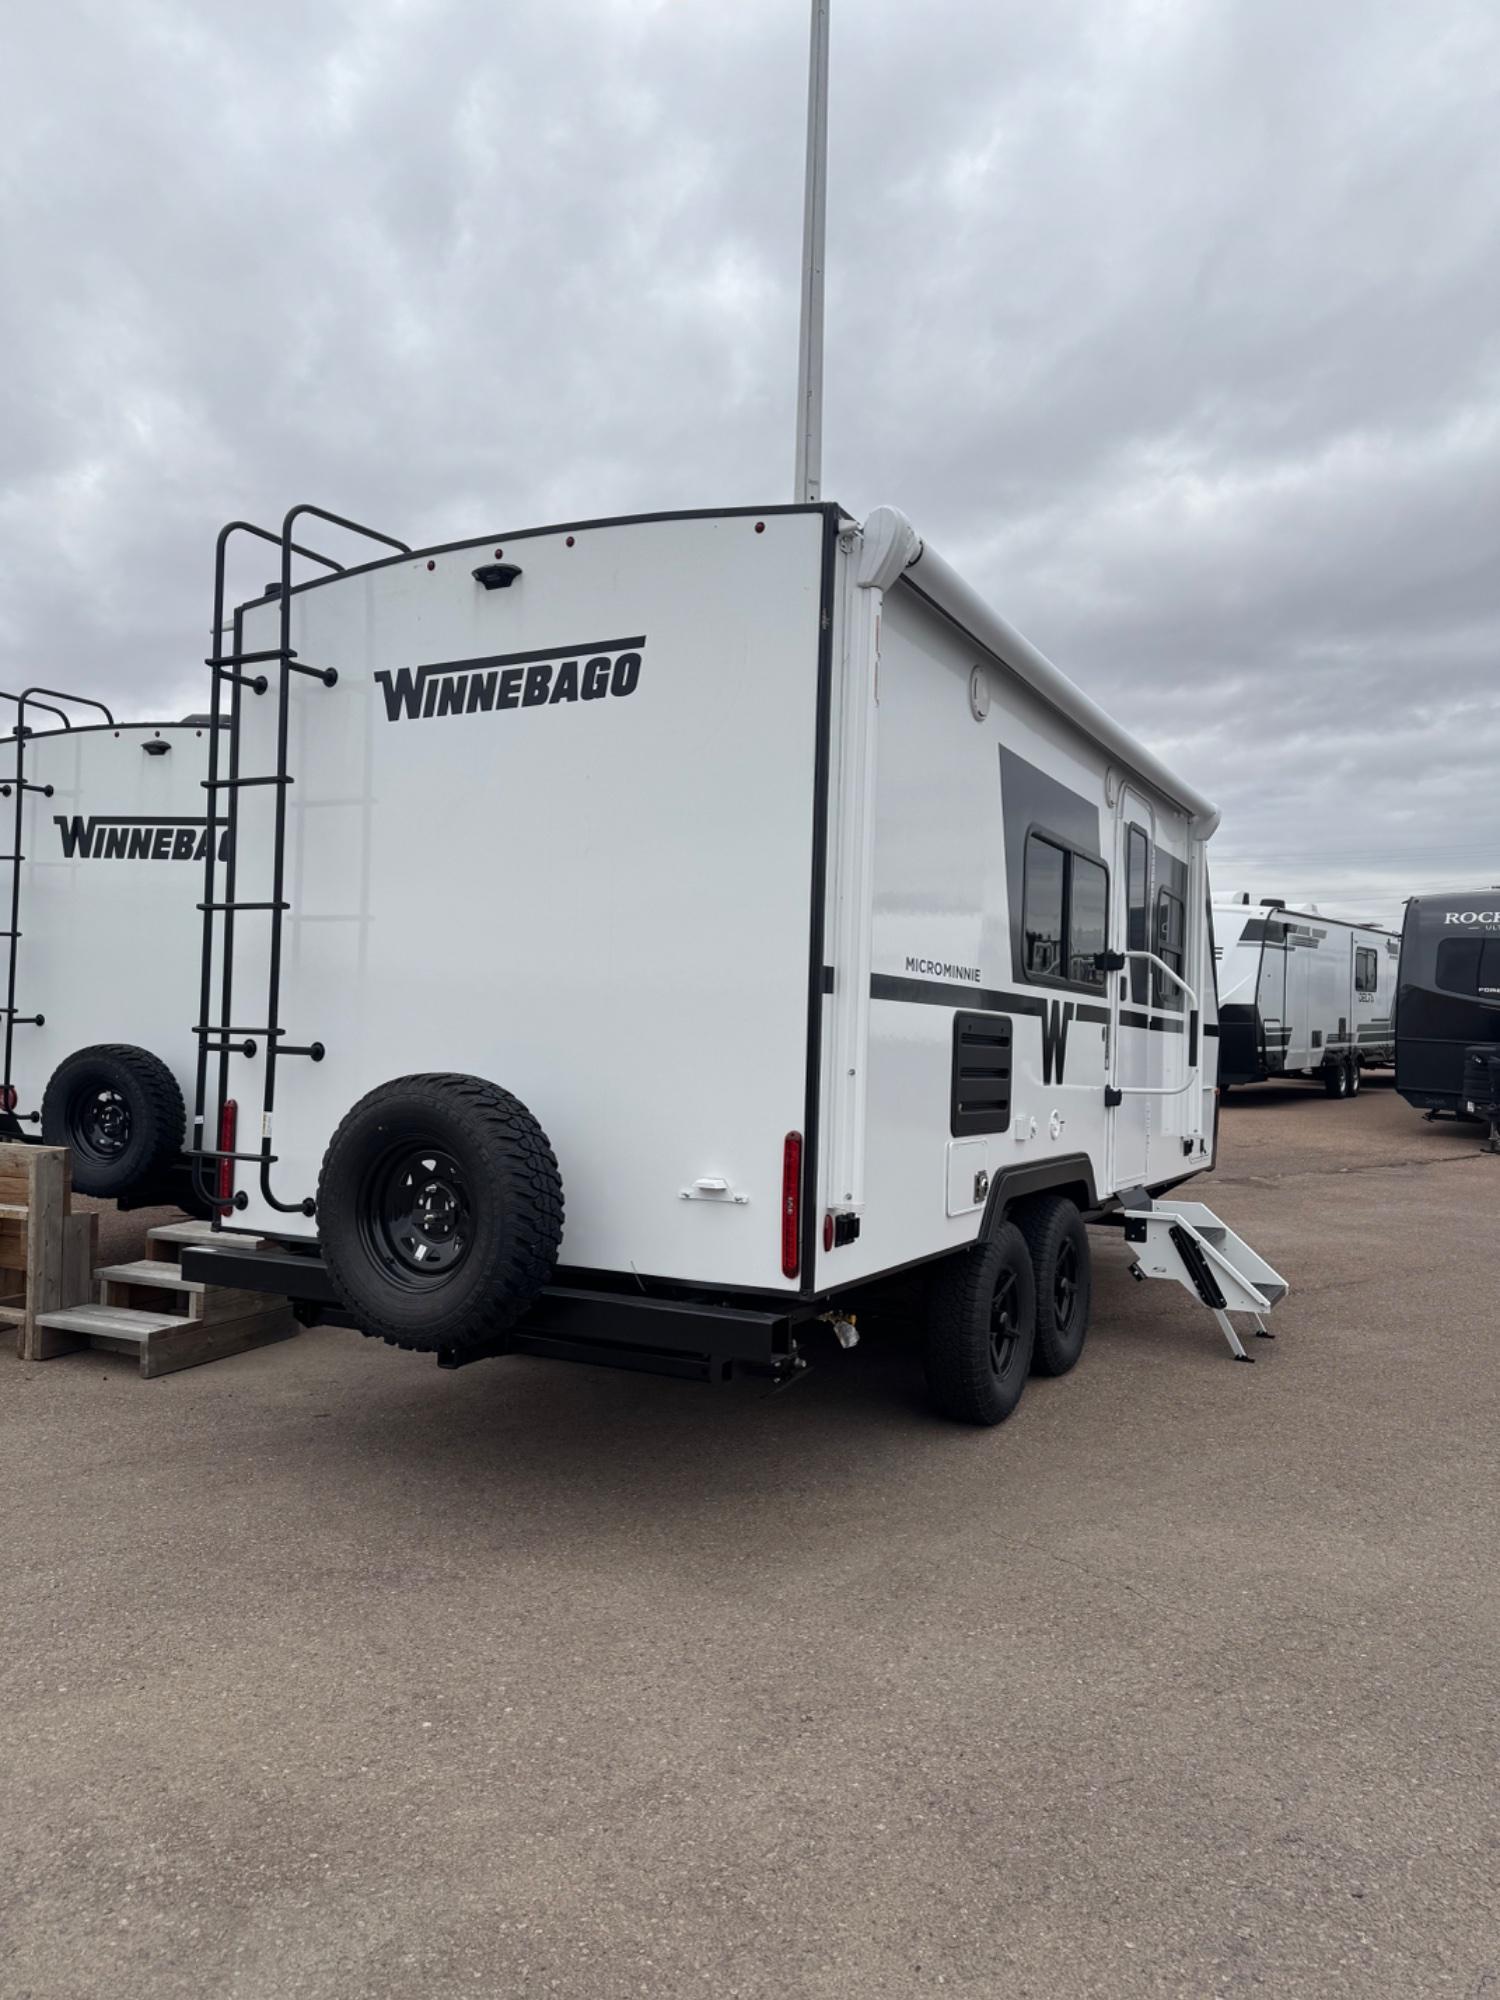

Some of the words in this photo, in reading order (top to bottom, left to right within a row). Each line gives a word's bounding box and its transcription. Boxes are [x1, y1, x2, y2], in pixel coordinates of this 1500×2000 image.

[374, 636, 646, 722] WINNEBAGO
[905, 956, 981, 983] MICROMINNIE
[1040, 998, 1075, 1085] W
